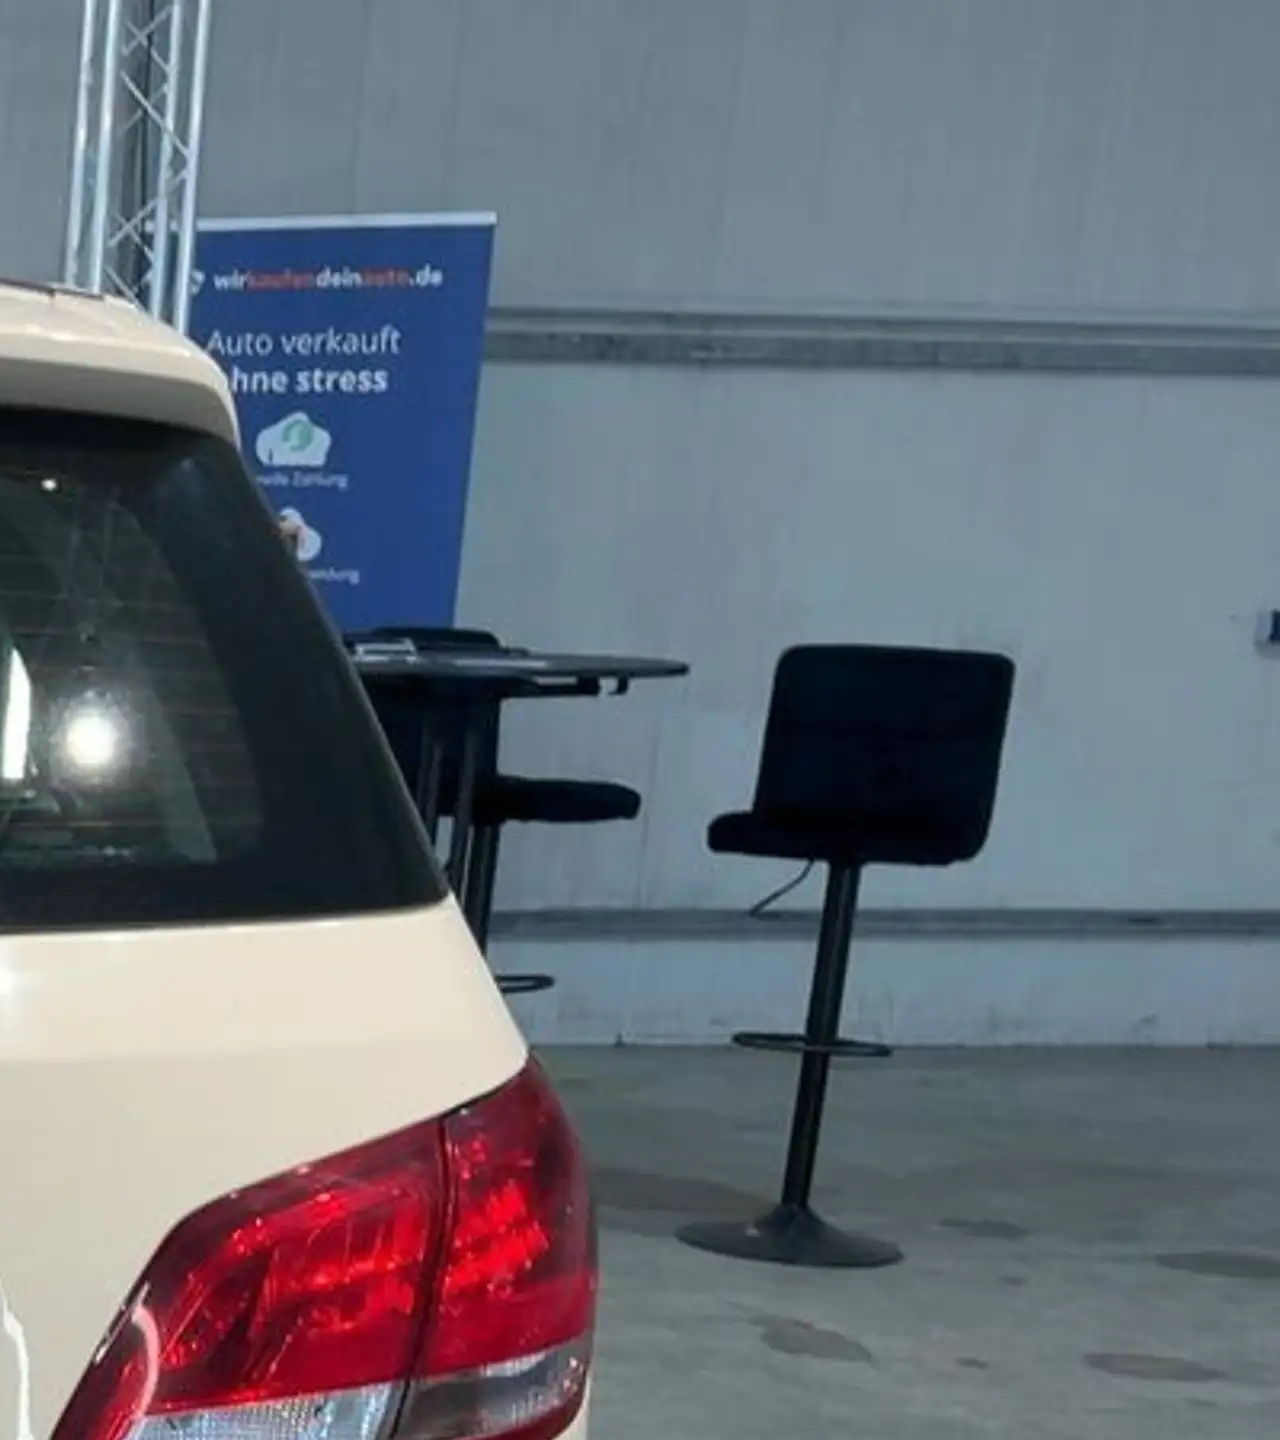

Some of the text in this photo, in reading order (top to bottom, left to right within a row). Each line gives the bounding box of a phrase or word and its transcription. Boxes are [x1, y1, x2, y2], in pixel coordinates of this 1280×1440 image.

[207, 324, 402, 357] Auto verkauft
[230, 364, 389, 395] hne stress
